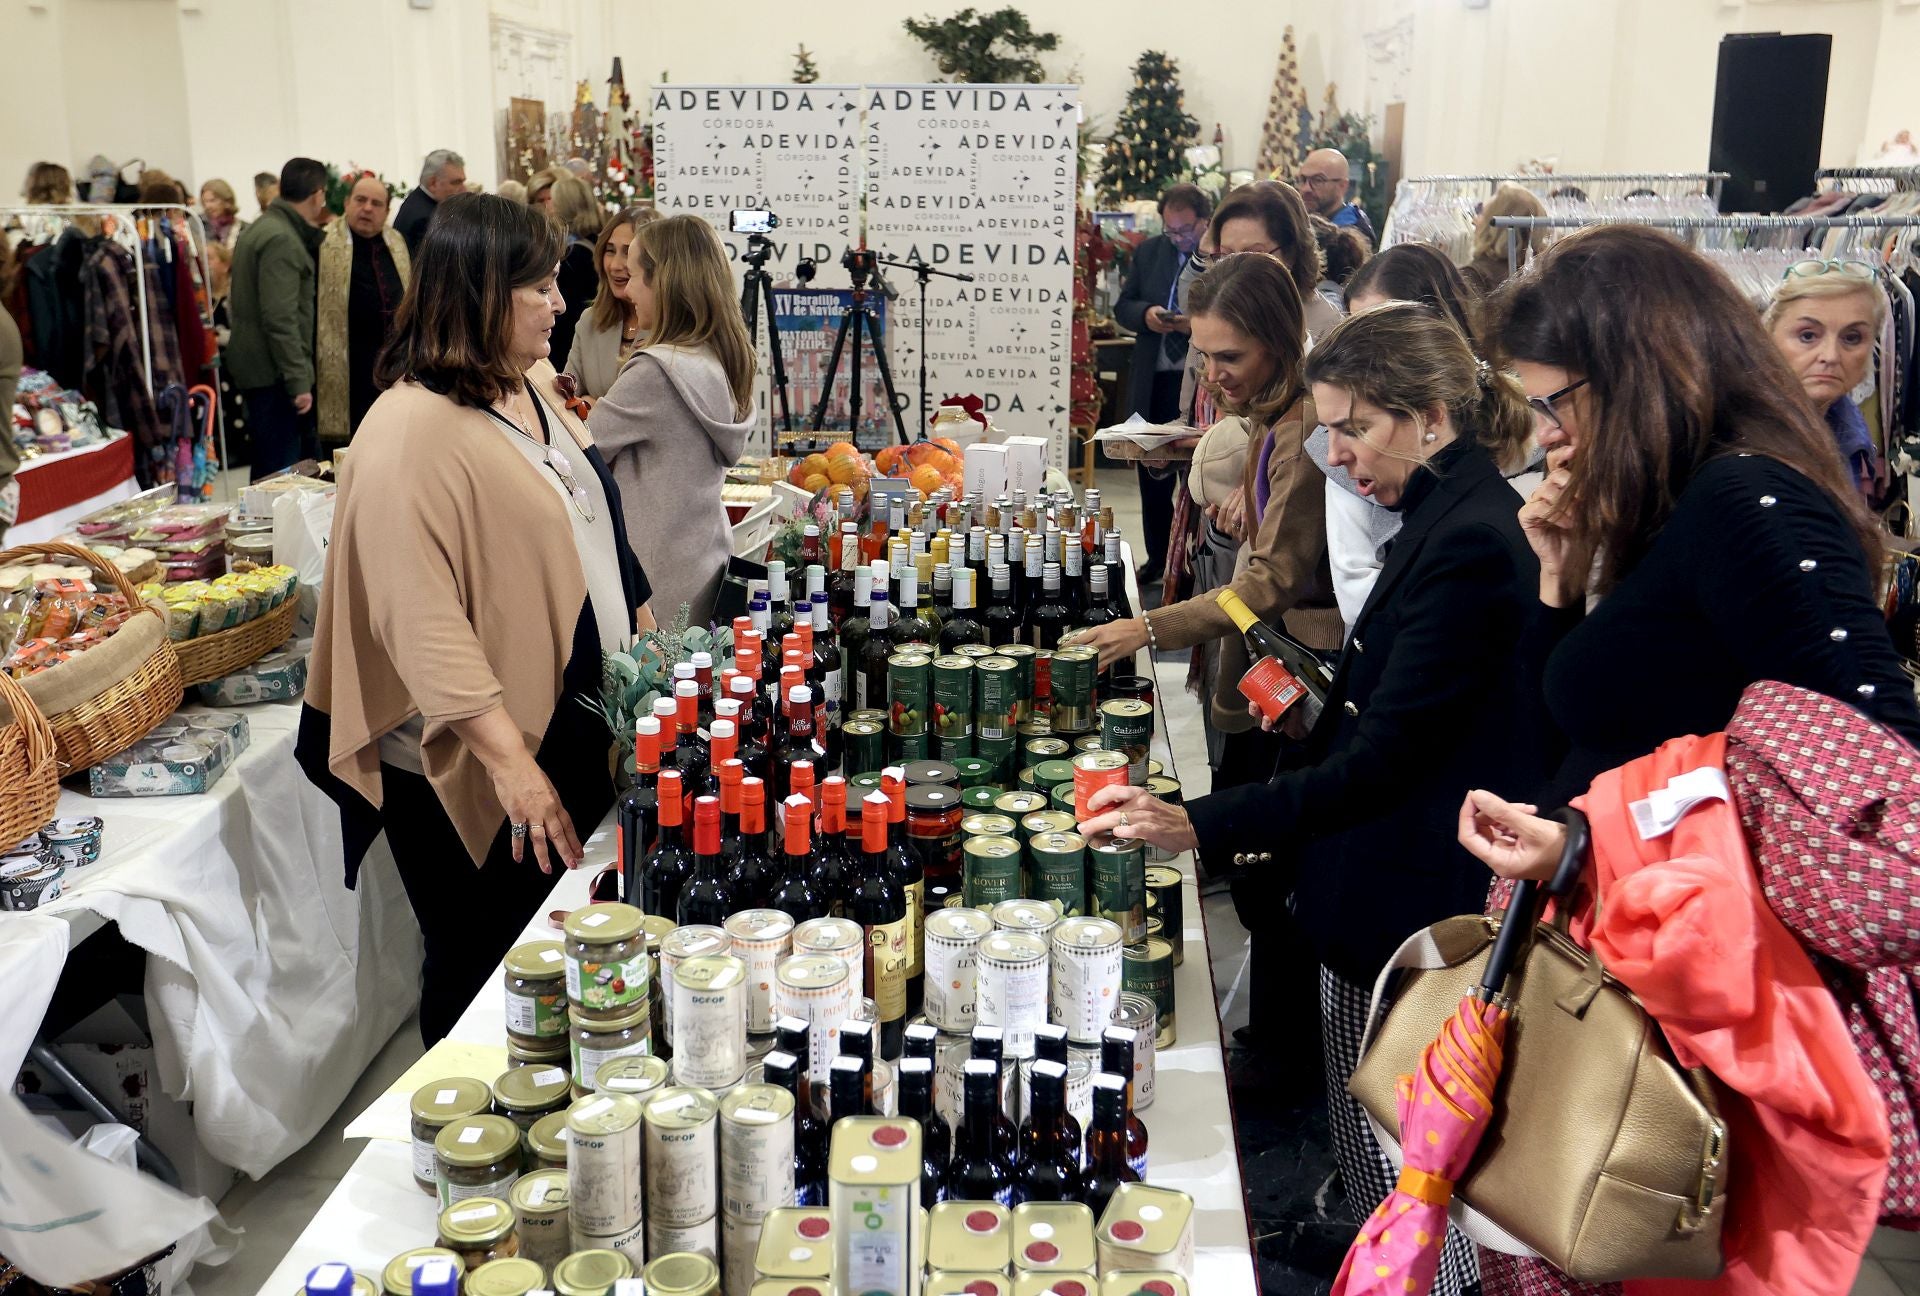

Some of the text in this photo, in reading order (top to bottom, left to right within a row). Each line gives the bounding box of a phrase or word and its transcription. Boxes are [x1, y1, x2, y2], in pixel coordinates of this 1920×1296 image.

[655, 90, 813, 111] ADEVIDA
[869, 90, 1031, 111] ADEVIDA
[744, 134, 855, 149] ADEVIDA
[958, 134, 1072, 149] ADEVIDA
[656, 122, 667, 205] ADEVIDA
[869, 122, 880, 205] ADEVIDA
[678, 166, 750, 176] ADEVIDA
[891, 166, 965, 176] ADEVIDA
[672, 195, 772, 209] ADEVIDA
[775, 194, 834, 202] ADEVIDA
[839, 154, 850, 237] ADEVIDA
[884, 196, 986, 209] ADEVIDA
[989, 195, 1050, 203] ADEVIDA
[1054, 154, 1066, 238] ADEVIDA
[869, 224, 921, 232] ADEVIDA
[977, 219, 1050, 229] ADEVIDA
[906, 244, 1071, 265] ADEVIDA
[892, 298, 953, 307] DEIDA
[956, 288, 1068, 303] ADEVIDA
[775, 294, 840, 316] XV Baratillo
[793, 305, 846, 316] de Navida
[795, 340, 827, 349] FELIPE
[987, 346, 1046, 354] ADEVIDA
[1050, 307, 1061, 388] ADEVIDA
[965, 369, 1037, 379] ADEVIDA
[1055, 428, 1063, 470] DEVIDA
